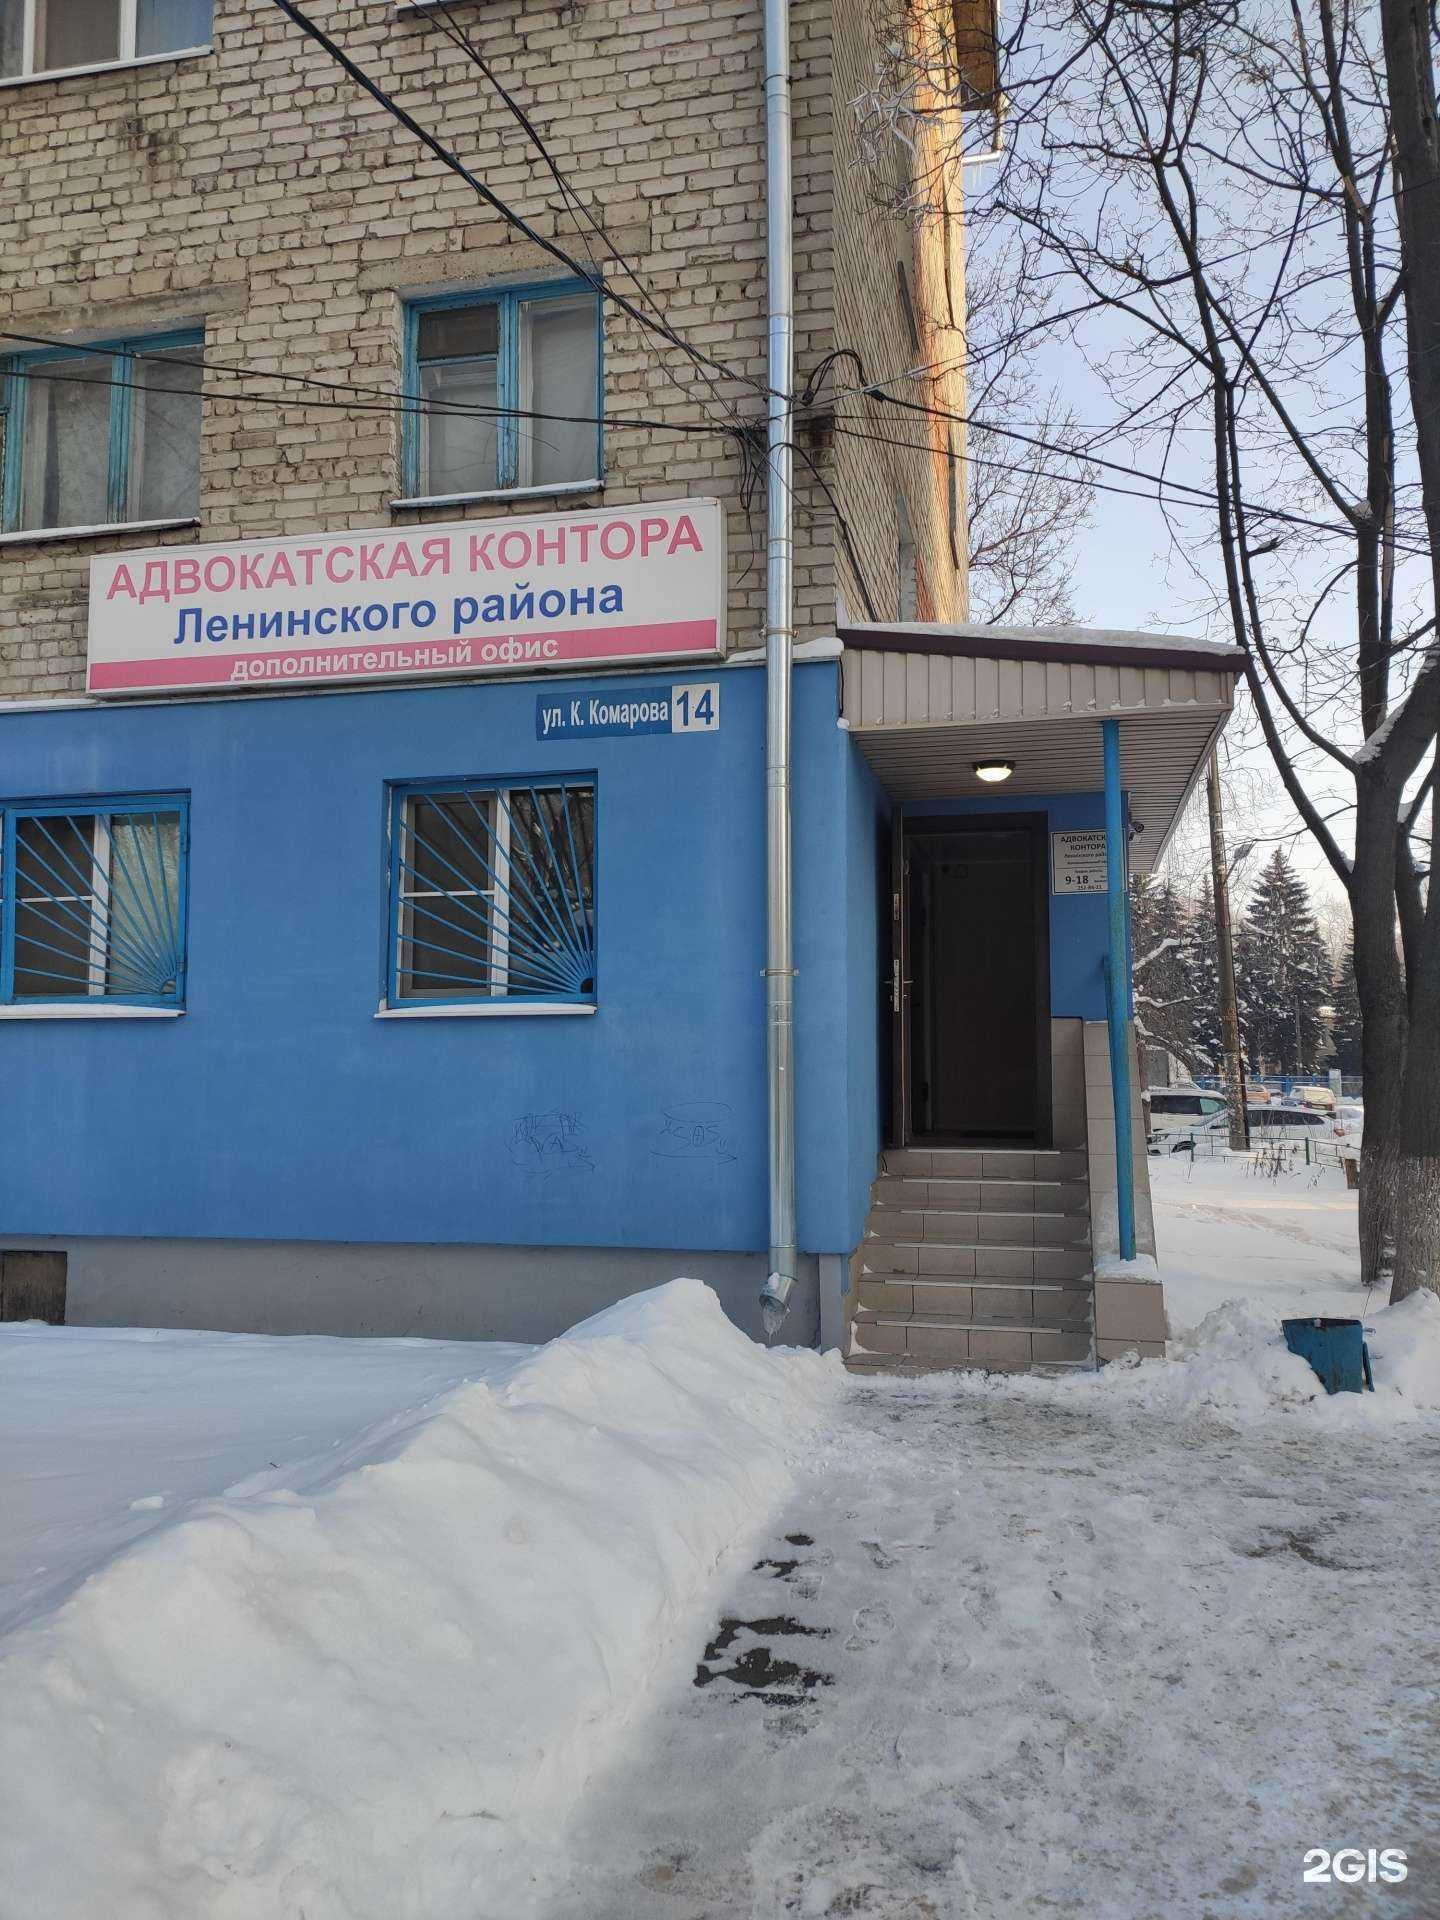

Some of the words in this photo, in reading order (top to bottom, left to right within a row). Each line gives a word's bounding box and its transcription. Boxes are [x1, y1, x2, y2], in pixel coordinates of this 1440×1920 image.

[106, 537, 450, 605] АДВОКАТСКАЯ
[469, 515, 704, 573] КОНТОРА
[173, 600, 437, 644] Ленинского
[453, 581, 623, 635] района
[230, 639, 472, 682] дополнительный
[481, 636, 560, 664] офис
[542, 707, 566, 735] ул.
[570, 700, 584, 727] К.
[589, 699, 669, 729] Комарова
[675, 689, 715, 727] 14
[1061, 835, 1106, 843] АДВОКАТСК
[1065, 875, 1089, 885] 9-18
